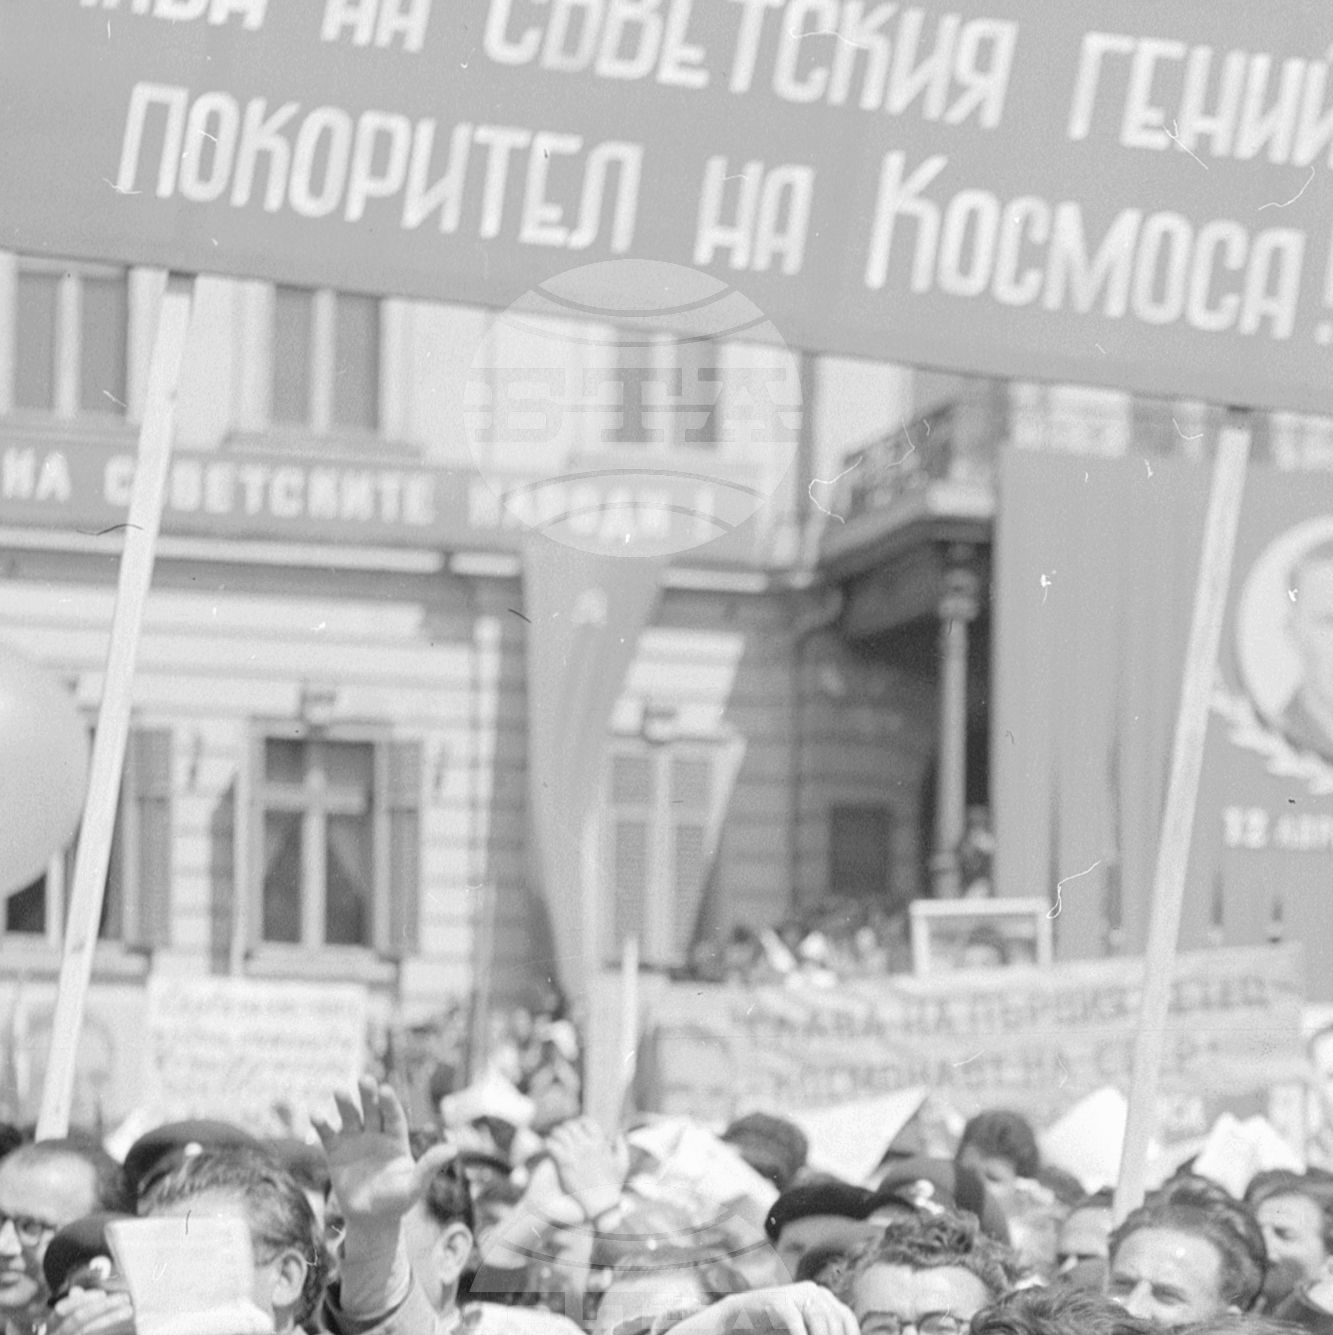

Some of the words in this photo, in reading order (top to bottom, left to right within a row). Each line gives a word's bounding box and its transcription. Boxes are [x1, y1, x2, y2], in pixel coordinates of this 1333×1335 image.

[482, 0, 1019, 131] СОВЕТСКИЯ
[115, 81, 643, 254] ПОКОРИТЕЛ
[693, 155, 815, 276] НА
[2, 447, 73, 503] НА
[104, 453, 436, 526] СВЕТСКИТЕ
[1222, 804, 1270, 849] 12
